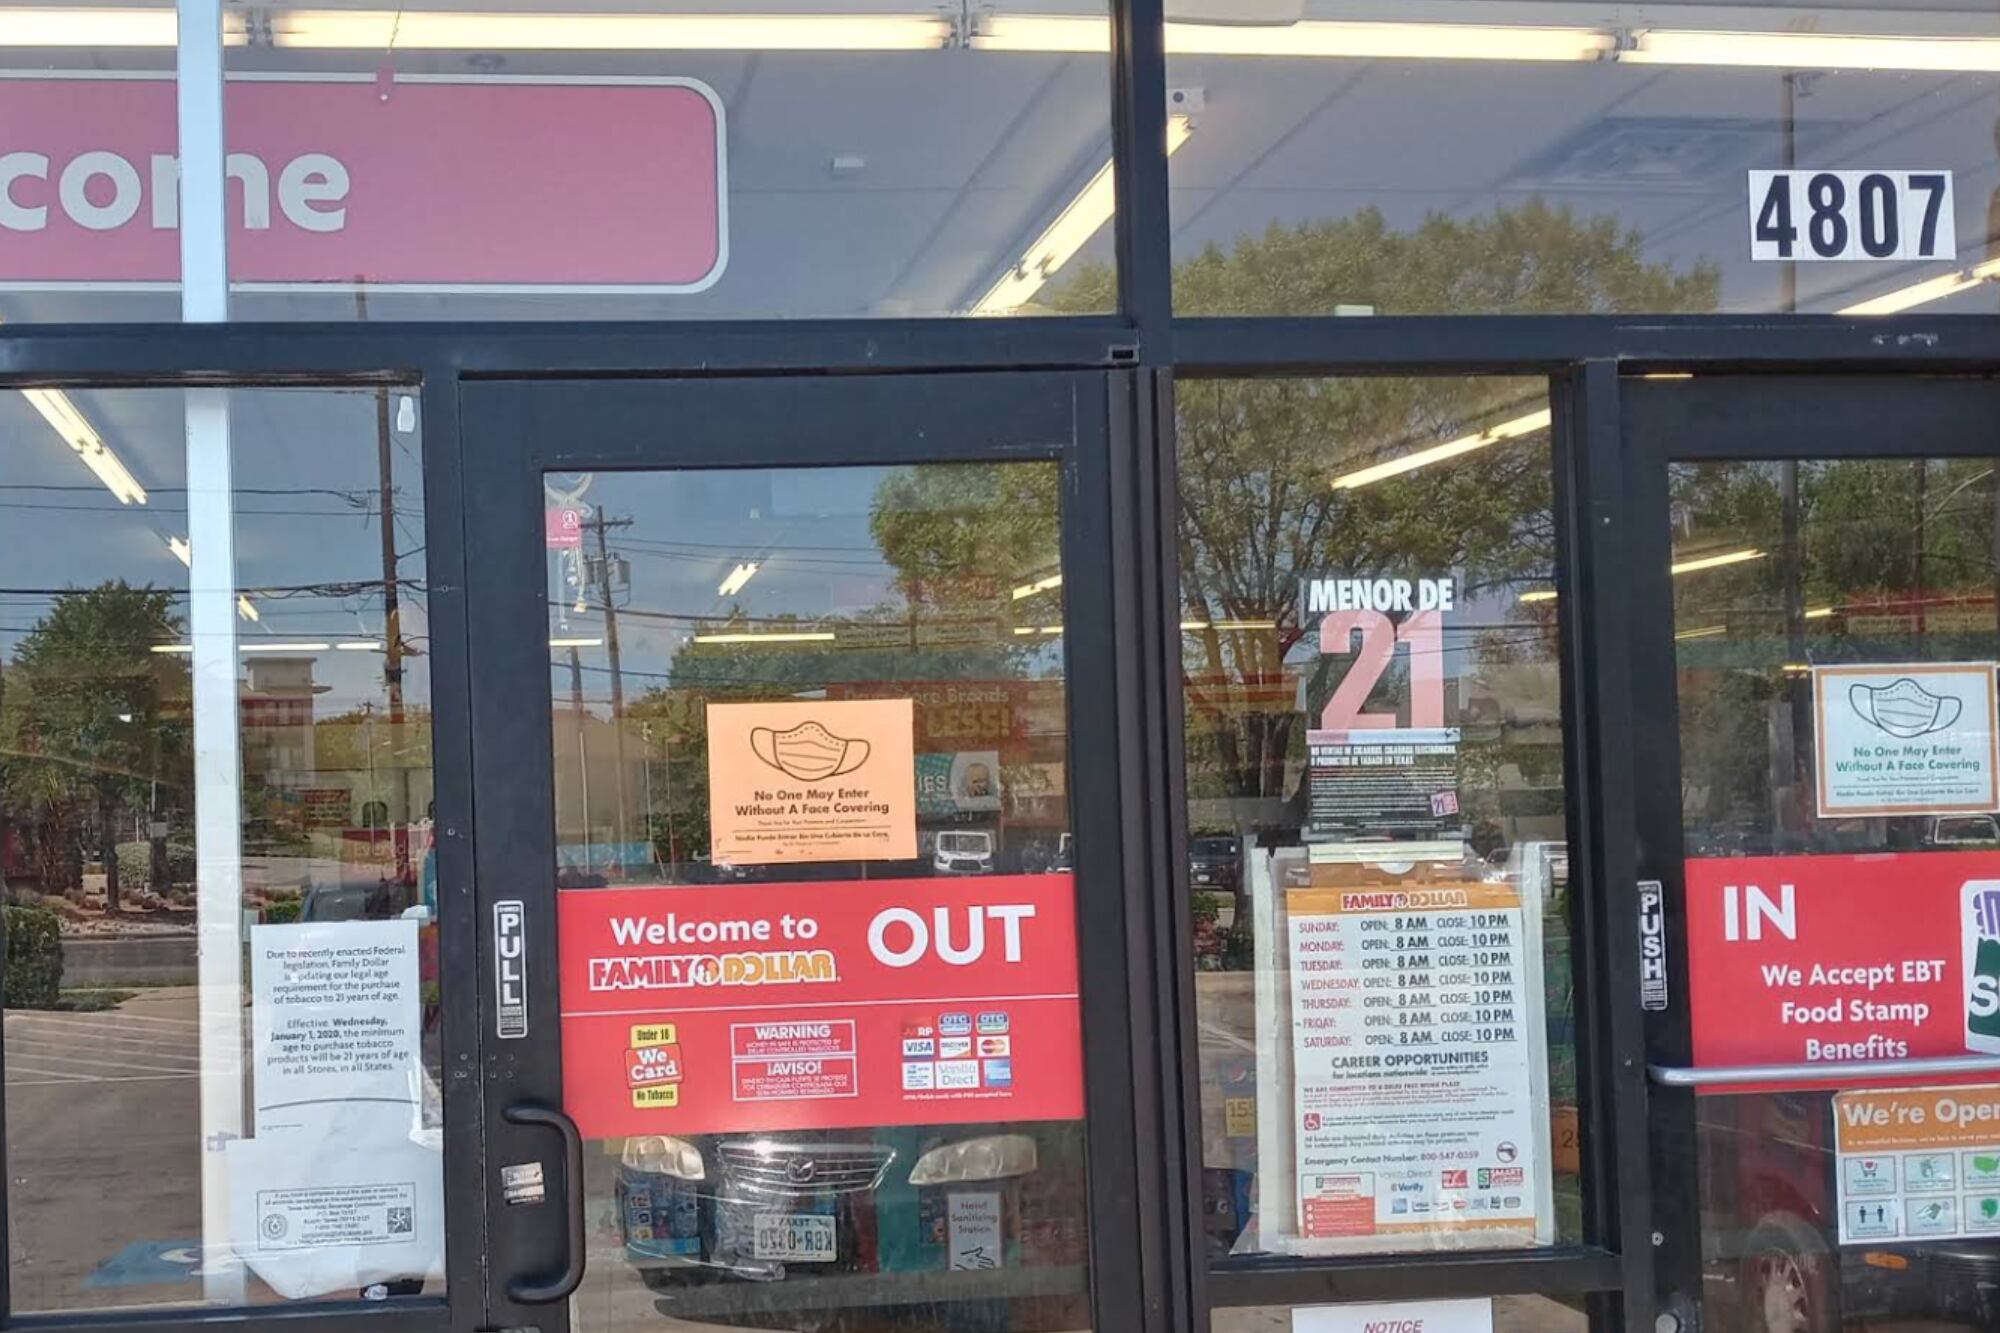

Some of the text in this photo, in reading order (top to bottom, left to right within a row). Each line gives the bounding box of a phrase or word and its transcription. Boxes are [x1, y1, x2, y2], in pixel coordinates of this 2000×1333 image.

[1756, 173, 1946, 258] 4807
[1308, 578, 1453, 612] MENOR DE
[1319, 609, 1445, 730] 21
[1854, 745, 1962, 758] No One May Enter
[1836, 758, 1980, 772] Without A Face Covering
[754, 788, 870, 801] No One May Enter
[735, 801, 889, 816] Without A Face Covering
[1341, 891, 1467, 909] FAMILY DOLLAR
[1722, 884, 1797, 941] IN
[610, 915, 819, 946] Welcome to
[1299, 922, 1339, 933] SUNDAY:
[1394, 918, 1403, 929] 8
[1406, 917, 1428, 928] AM
[1470, 915, 1486, 927] 10
[1489, 914, 1509, 926] PM
[867, 904, 1036, 967] OUT
[1299, 941, 1344, 952] MONDAY:
[1396, 937, 1404, 948] 8
[1407, 936, 1429, 948] AM
[1472, 935, 1487, 946] 10
[1490, 933, 1510, 945] PM
[1641, 892, 1662, 980] PUSH
[266, 951, 284, 959] Due
[286, 949, 297, 959] to
[298, 948, 334, 960] recently
[336, 947, 372, 957] enacted
[500, 913, 520, 1005] PULL
[1301, 960, 1344, 971] TUESDAY:
[1397, 956, 1404, 967] 8
[1408, 955, 1430, 967] AM
[1473, 954, 1488, 965] 10
[1491, 952, 1511, 964] PM
[331, 959, 361, 969] Family
[362, 958, 389, 967] Dollar
[589, 950, 837, 990] FAMILY DOLLAR
[333, 971, 349, 979] our
[350, 969, 372, 979] legal
[373, 970, 389, 979] age
[1300, 979, 1361, 990] WEDNESDAY:
[1398, 975, 1405, 986] 8
[1408, 974, 1430, 986] AM
[1474, 972, 1489, 983] 10
[1492, 971, 1512, 983] PM
[1761, 959, 1946, 989] We Accept EBT
[273, 979, 400, 994] requirement for the purchase
[274, 995, 285, 1004] of
[285, 993, 322, 1003] tobacco
[323, 993, 334, 1002] to
[336, 992, 345, 1001] 21
[346, 992, 369, 1003] years
[370, 991, 381, 1001] of
[1302, 998, 1352, 1009] THURSDAY:
[1398, 994, 1406, 1006] 8
[1409, 993, 1431, 1005] AM
[1475, 991, 1490, 1002] 10
[1493, 990, 1513, 1002] PM
[332, 1016, 388, 1028] Wednesday,
[1399, 1013, 1407, 1024] 8
[1410, 1012, 1431, 1024] AM
[1475, 1010, 1490, 1021] 10
[1493, 1008, 1513, 1020] PM
[1781, 1001, 1929, 1027] Food Stamp
[270, 1031, 307, 1043] January
[343, 1028, 360, 1037] the
[361, 1027, 404, 1037] minimum
[636, 1030, 658, 1041] Under
[754, 1024, 831, 1040] WARNING
[1304, 1036, 1352, 1048] SATURDAY:
[1400, 1032, 1408, 1043] 8
[1411, 1031, 1432, 1043] AM
[1476, 1029, 1491, 1040] 10
[1494, 1027, 1515, 1039] PM
[282, 1039, 394, 1053] age to purchase tobacco
[905, 1040, 933, 1053] VISA
[1805, 1033, 1908, 1062] Benefits
[267, 1053, 309, 1065] products
[310, 1052, 328, 1062] will
[329, 1051, 340, 1061] be
[354, 1051, 379, 1062] years
[380, 1050, 392, 1059] of
[393, 1050, 409, 1060] age
[636, 1048, 668, 1065] We
[1331, 1051, 1489, 1069] CAREER OPPORTUNITIES
[631, 1059, 678, 1080] Card
[942, 1075, 974, 1086] Direct
[636, 1089, 674, 1101] No Tobacco
[1842, 1101, 1926, 1126] We're
[1305, 1157, 1349, 1168] Emergency
[1351, 1155, 1382, 1164] Contact
[1363, 1319, 1424, 1333] NOTICE
